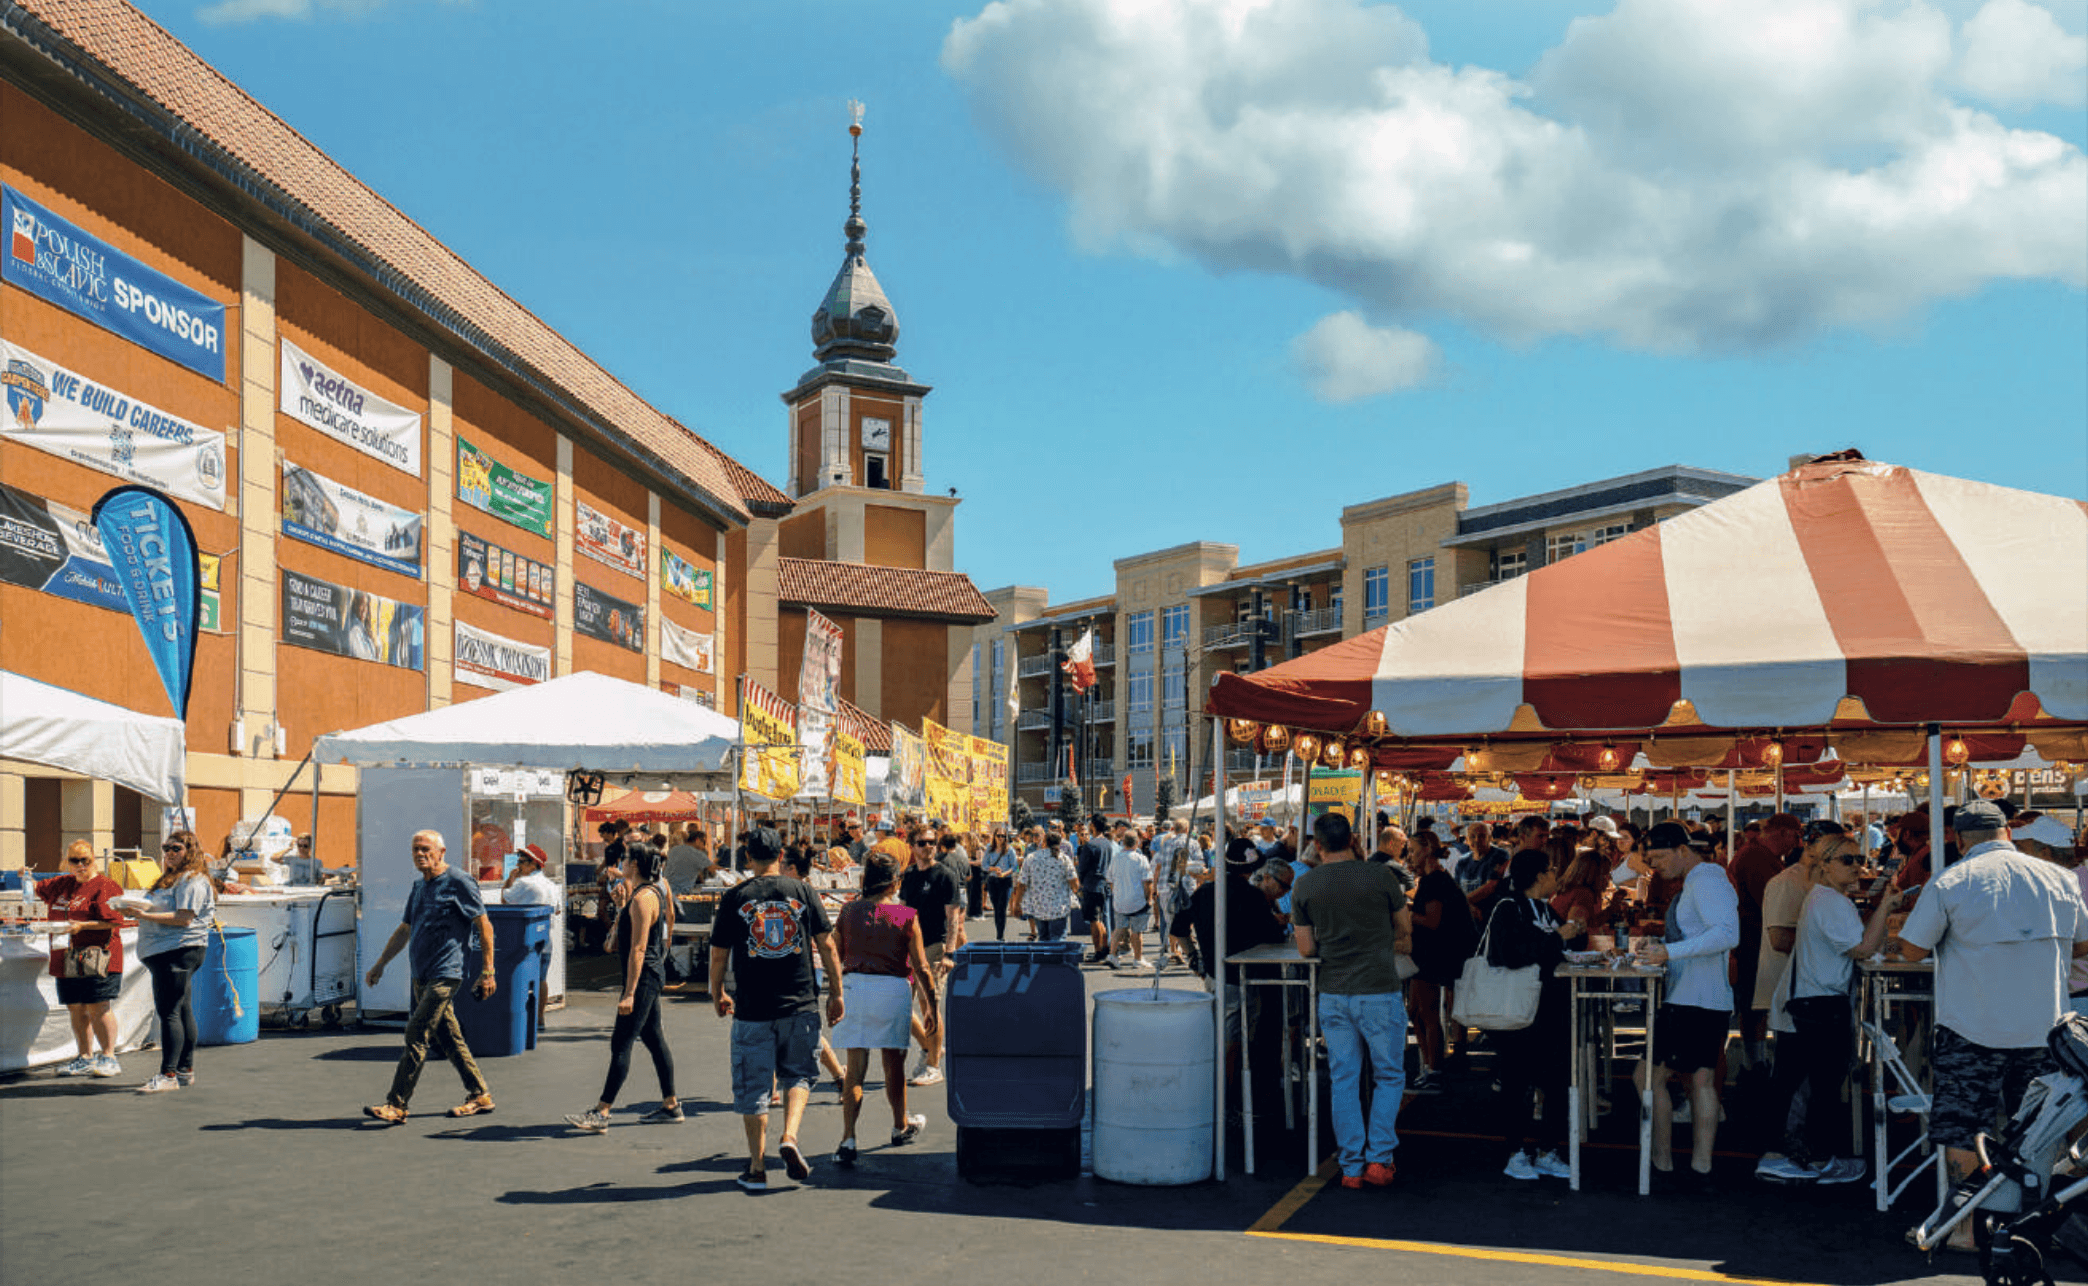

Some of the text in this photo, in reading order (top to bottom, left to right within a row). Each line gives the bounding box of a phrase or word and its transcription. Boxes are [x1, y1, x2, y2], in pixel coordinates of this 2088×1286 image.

[35, 221, 105, 278] POLISH
[113, 277, 218, 353] SPONSOR
[52, 370, 80, 402] WE
[80, 384, 129, 421] BUILD
[130, 405, 194, 446] CAREERS
[300, 396, 408, 463] medicare solutions
[315, 372, 364, 417] aetna
[104, 582, 125, 598] ULT
[118, 526, 137, 565] FOOD
[134, 581, 155, 622] DRINK
[130, 501, 184, 642] TICKETS
